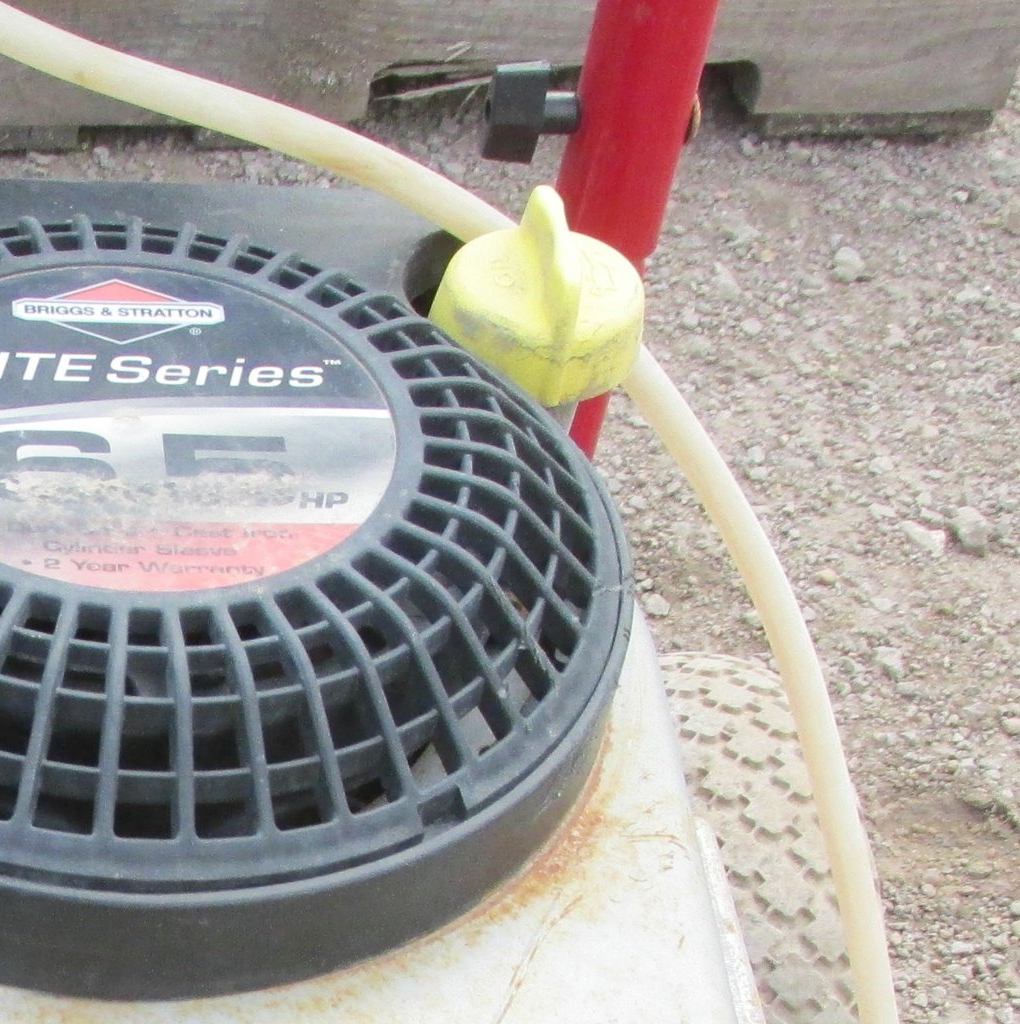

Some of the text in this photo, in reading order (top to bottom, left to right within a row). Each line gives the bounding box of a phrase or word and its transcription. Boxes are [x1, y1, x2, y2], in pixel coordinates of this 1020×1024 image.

[23, 304, 213, 319] BRIGGS & STRATTON
[298, 491, 350, 509] HP
[43, 557, 266, 577] 2 Year Warranty
